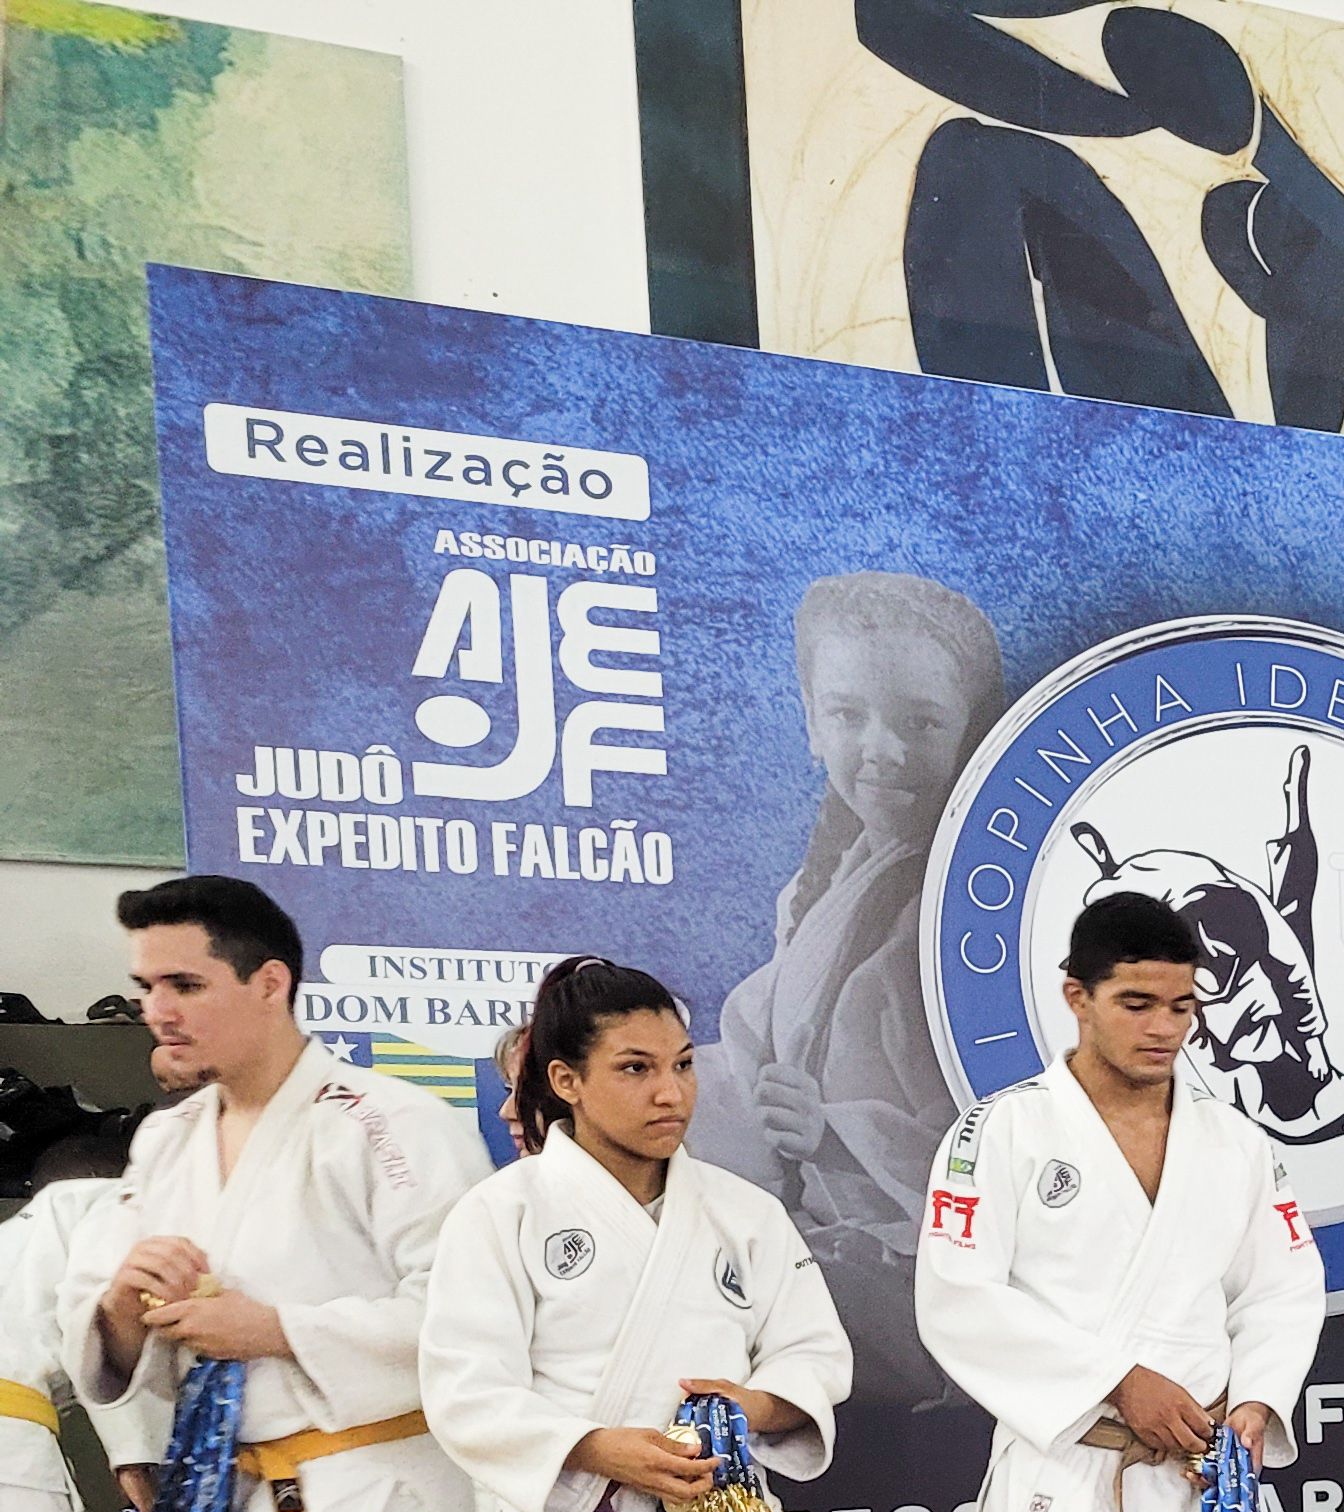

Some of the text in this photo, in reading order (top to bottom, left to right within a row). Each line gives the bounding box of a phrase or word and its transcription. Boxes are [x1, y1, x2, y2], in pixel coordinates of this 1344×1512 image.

[245, 417, 613, 501] Realização
[434, 530, 656, 577] ASSOCIAÇÃO
[235, 744, 403, 805] JUDÔ
[236, 805, 674, 885] EXPEDITO FALCÃO
[961, 673, 1193, 976] COPINHA
[303, 993, 411, 1024] DOM
